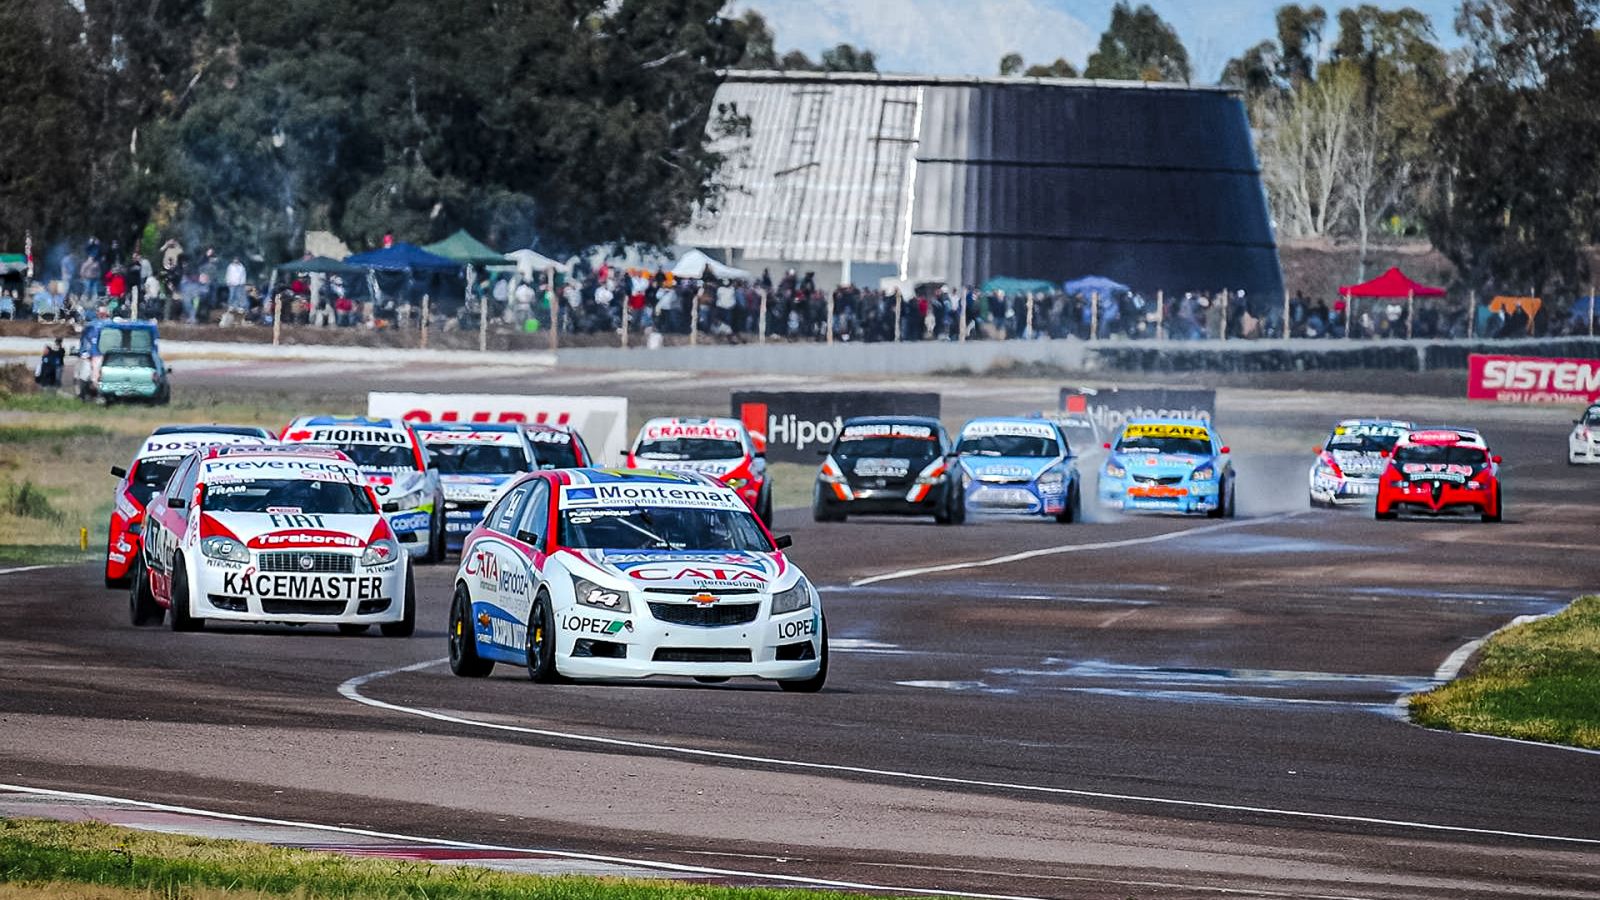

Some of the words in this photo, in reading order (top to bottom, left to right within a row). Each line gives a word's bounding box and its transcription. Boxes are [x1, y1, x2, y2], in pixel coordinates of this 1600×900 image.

[313, 429, 406, 444] FIORINO
[648, 426, 737, 438] CRAMACO
[207, 485, 247, 497] FRAM
[600, 485, 733, 502] Montemar
[661, 499, 718, 507] Financiera
[268, 514, 324, 529] FIAT
[257, 533, 361, 547] Taraborelli
[466, 551, 498, 581] CATA
[628, 568, 768, 582] CATA
[223, 571, 383, 600] KACEMASTER
[693, 579, 765, 590] internacional
[586, 590, 621, 607] 14
[562, 615, 612, 635] LOPEZ
[778, 619, 816, 639] LOPEZ
